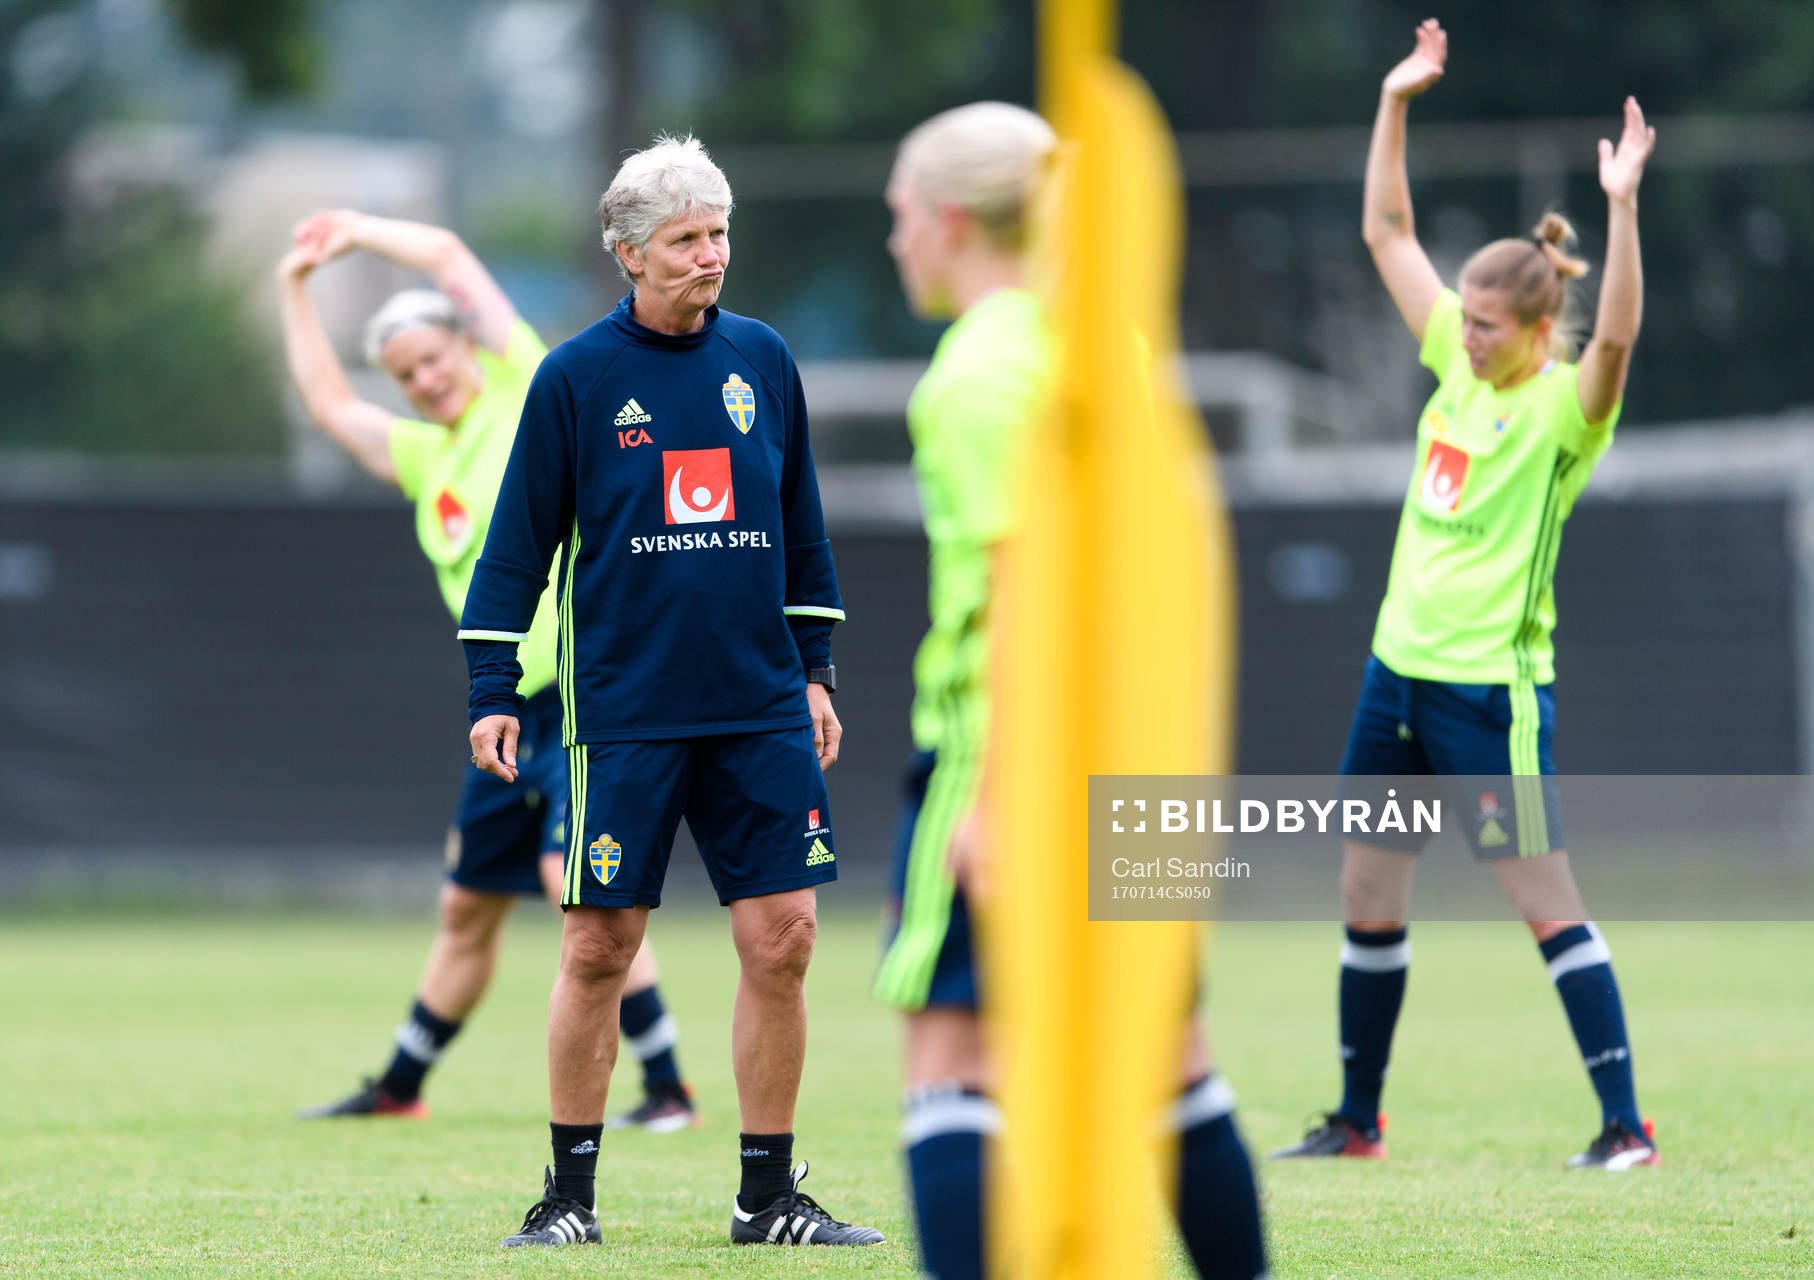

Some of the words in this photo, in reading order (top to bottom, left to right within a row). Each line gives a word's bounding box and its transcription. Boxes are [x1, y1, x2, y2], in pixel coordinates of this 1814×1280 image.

[614, 413, 652, 426] adidas
[617, 428, 654, 449] ICA
[630, 532, 724, 554] SVENSKA
[728, 531, 772, 548] SPEL
[806, 853, 835, 866] adidas
